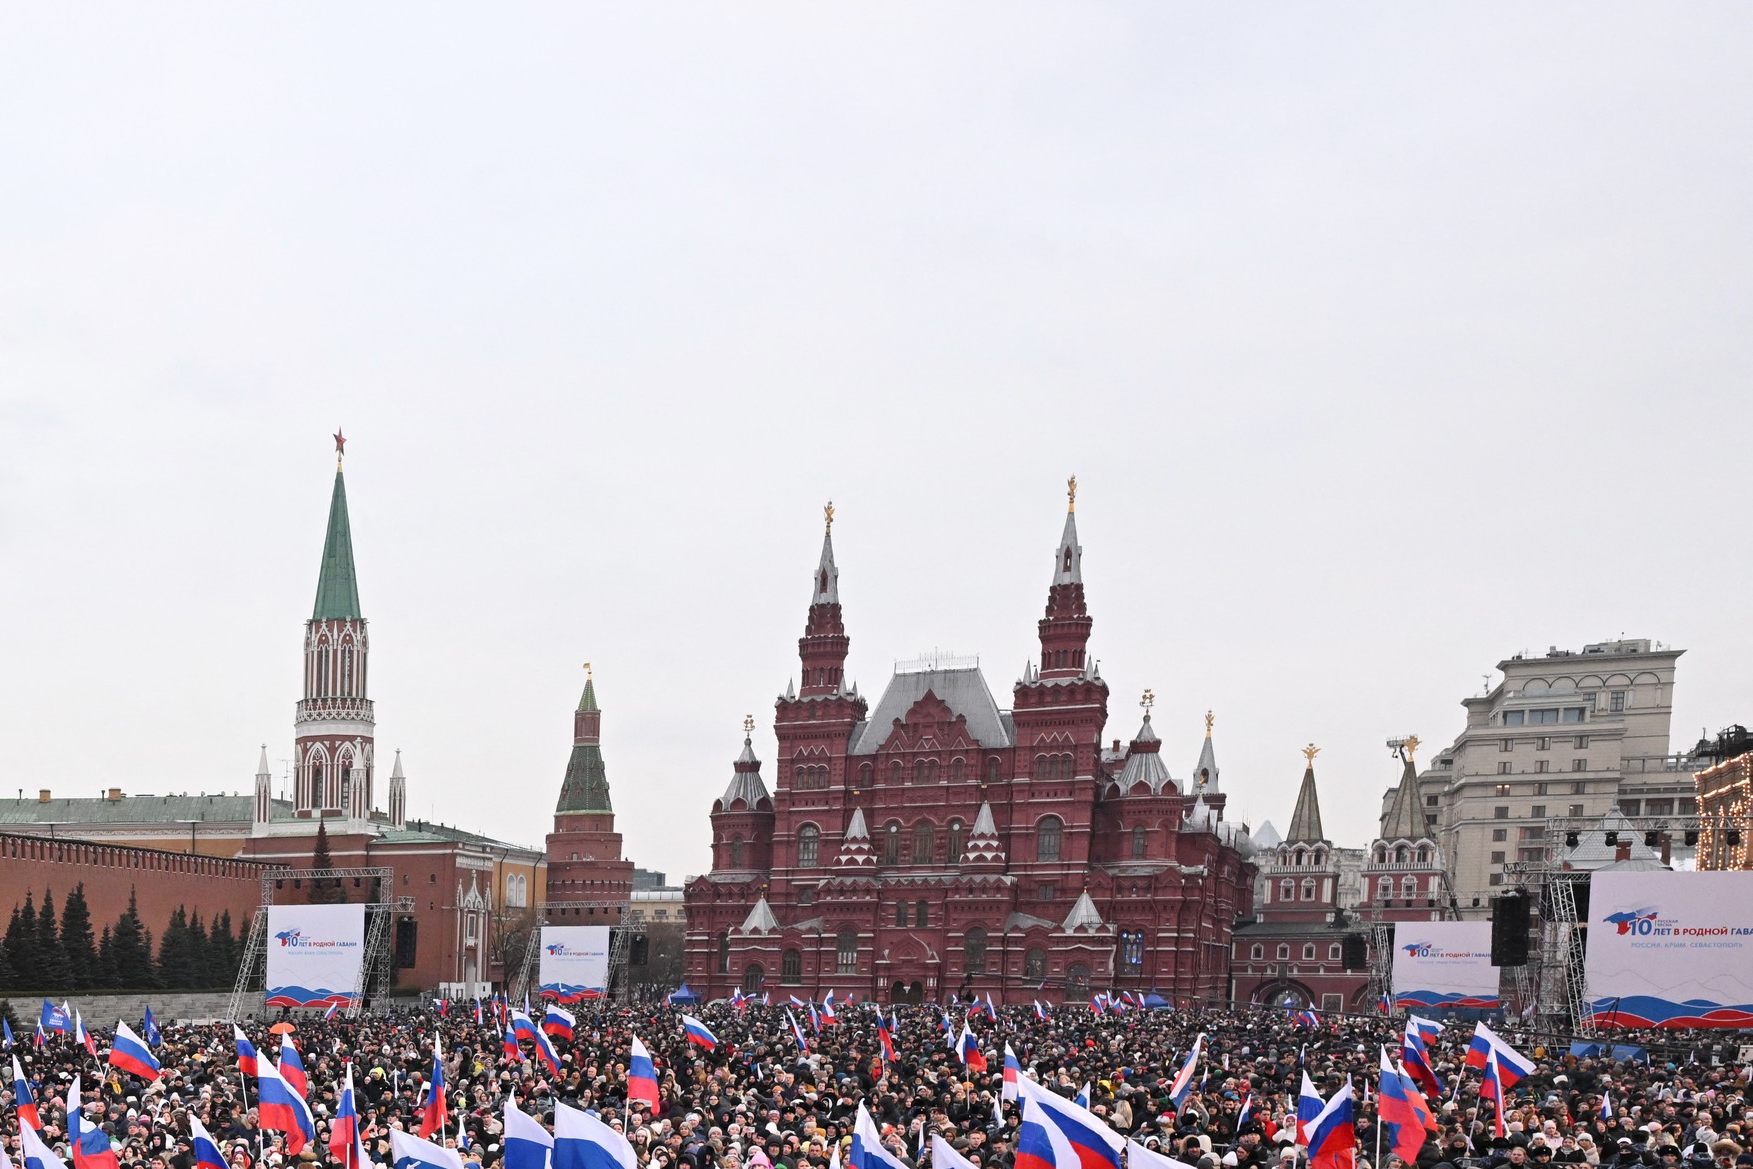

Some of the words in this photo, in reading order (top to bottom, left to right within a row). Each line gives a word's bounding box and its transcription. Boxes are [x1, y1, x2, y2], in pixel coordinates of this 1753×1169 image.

[1628, 919, 1652, 936] 10
[1653, 928, 1671, 936] ЛЕТ
[1673, 928, 1680, 936] В
[1682, 926, 1728, 937] РОДНОЙ
[286, 936, 298, 947] 10
[312, 940, 335, 948] РОДНОЙ
[1416, 948, 1429, 957] 10
